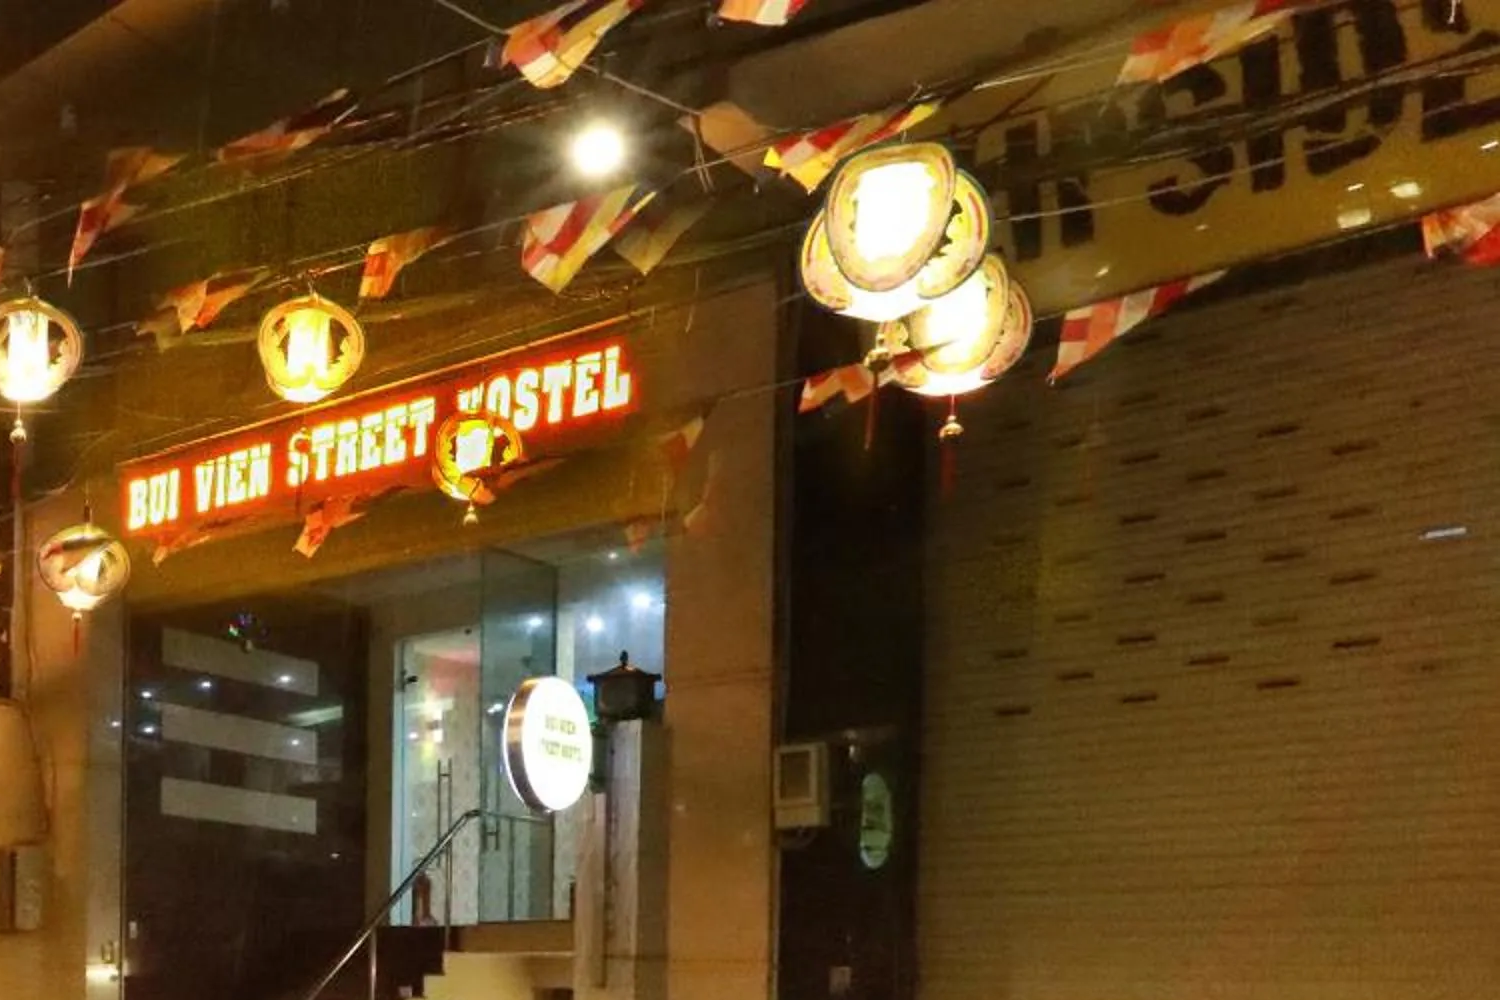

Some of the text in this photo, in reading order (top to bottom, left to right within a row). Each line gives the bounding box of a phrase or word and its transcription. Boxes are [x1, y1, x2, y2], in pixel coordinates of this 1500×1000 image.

[127, 467, 181, 532] BUI
[194, 442, 272, 514] VIEN
[286, 396, 436, 487] STREET
